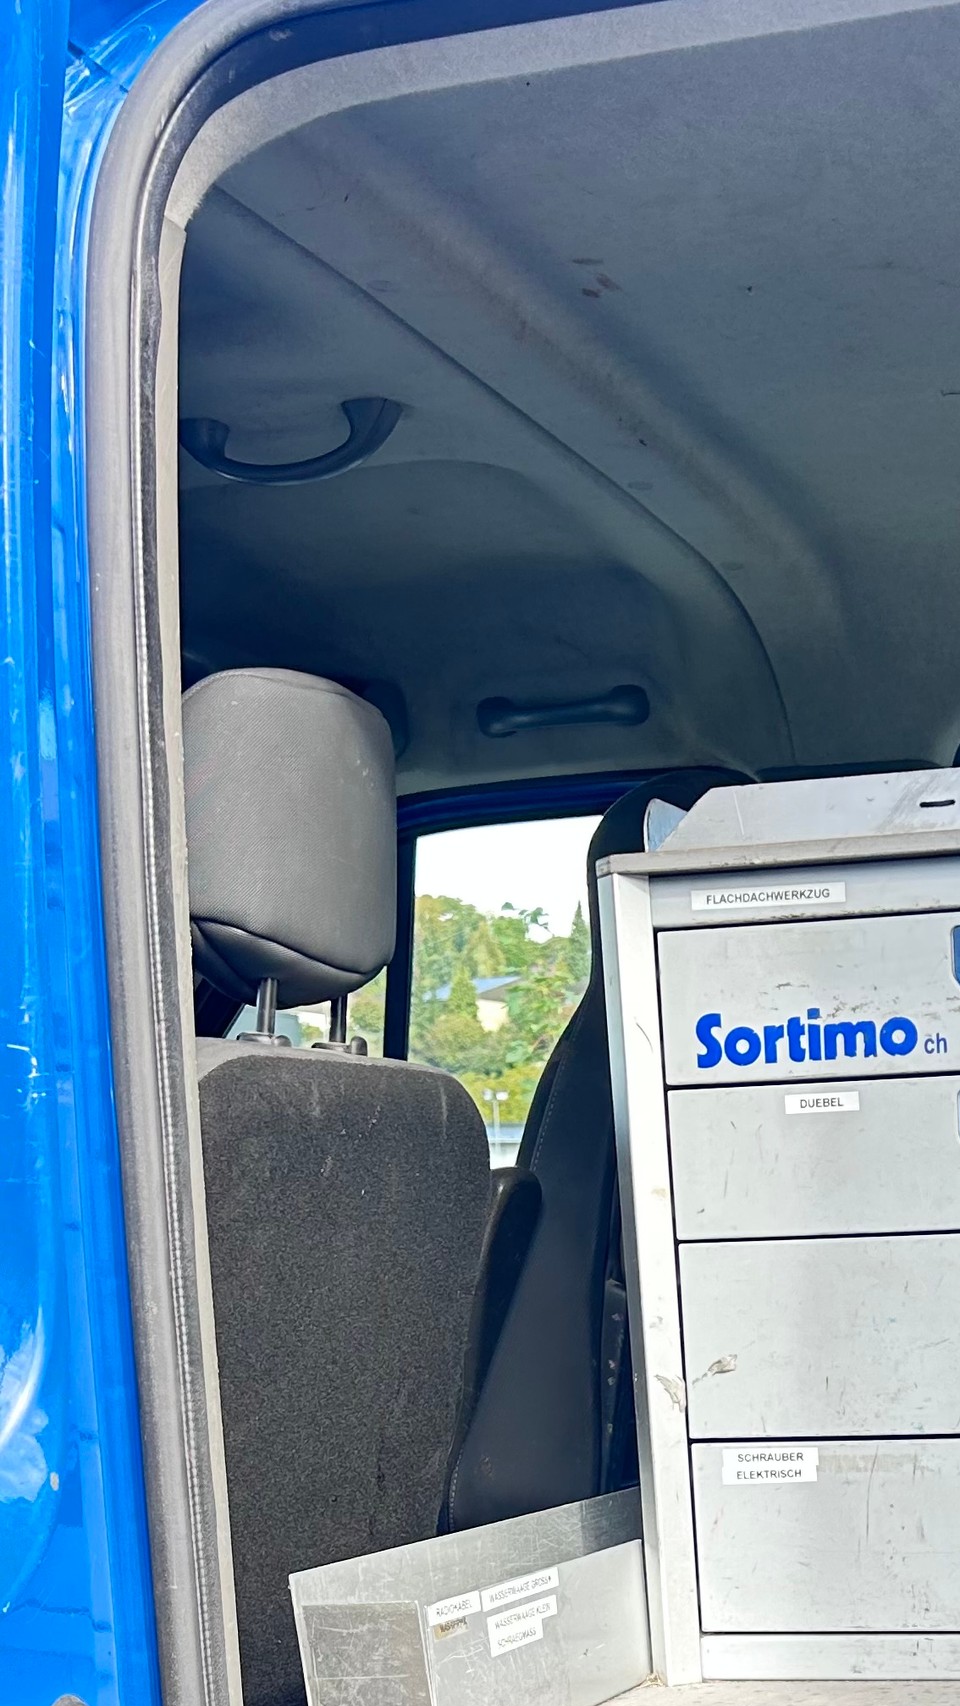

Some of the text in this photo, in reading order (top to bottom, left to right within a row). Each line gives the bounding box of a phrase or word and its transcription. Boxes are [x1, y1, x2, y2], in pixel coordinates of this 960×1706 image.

[706, 887, 830, 905] FLACHDACHWERKZUG
[696, 1008, 948, 1069] Sortimo ch
[800, 1097, 844, 1109] DUEBEL
[737, 1452, 804, 1463] SCHRAUBER
[736, 1469, 802, 1480] ELEKTRISCH
